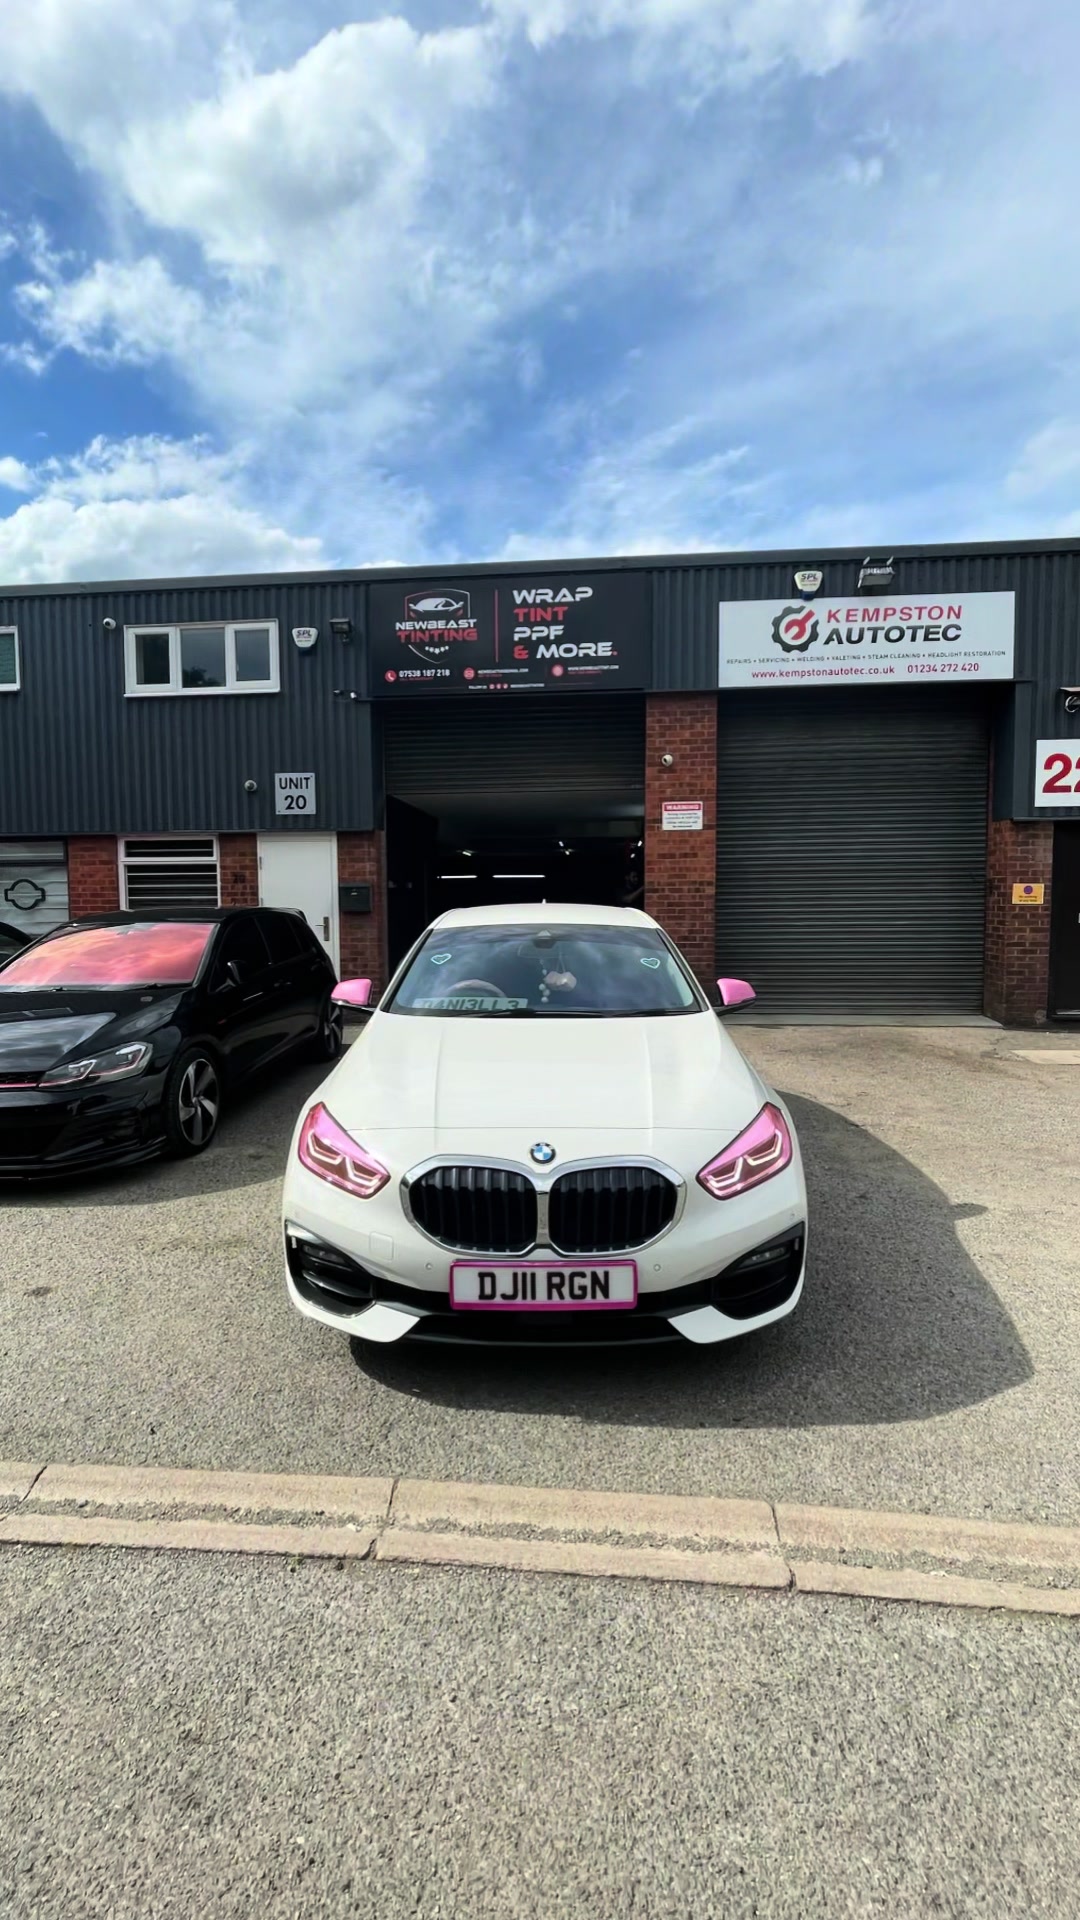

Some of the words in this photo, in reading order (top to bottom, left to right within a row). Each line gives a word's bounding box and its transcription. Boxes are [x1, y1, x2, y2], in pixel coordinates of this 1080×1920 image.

[512, 586, 593, 604] WRAP
[513, 606, 569, 622] TINT
[827, 605, 962, 623] KEMPSTON
[395, 618, 477, 630] NEWBEAST
[397, 628, 478, 643] TINTING
[513, 625, 565, 641] PPF
[823, 624, 962, 645] AUTOTEC
[513, 645, 529, 659] &
[868, 652, 889, 660] STEAM
[889, 652, 921, 660] CLEANING
[751, 665, 895, 678] www.kempstonautotec.co.uk
[907, 664, 938, 673] 01234
[940, 663, 959, 672] 272
[961, 662, 980, 672] 420
[1042, 754, 1080, 793] 2
[279, 776, 311, 790] UNIT
[284, 794, 307, 810] 20
[546, 1270, 610, 1301] RGN
